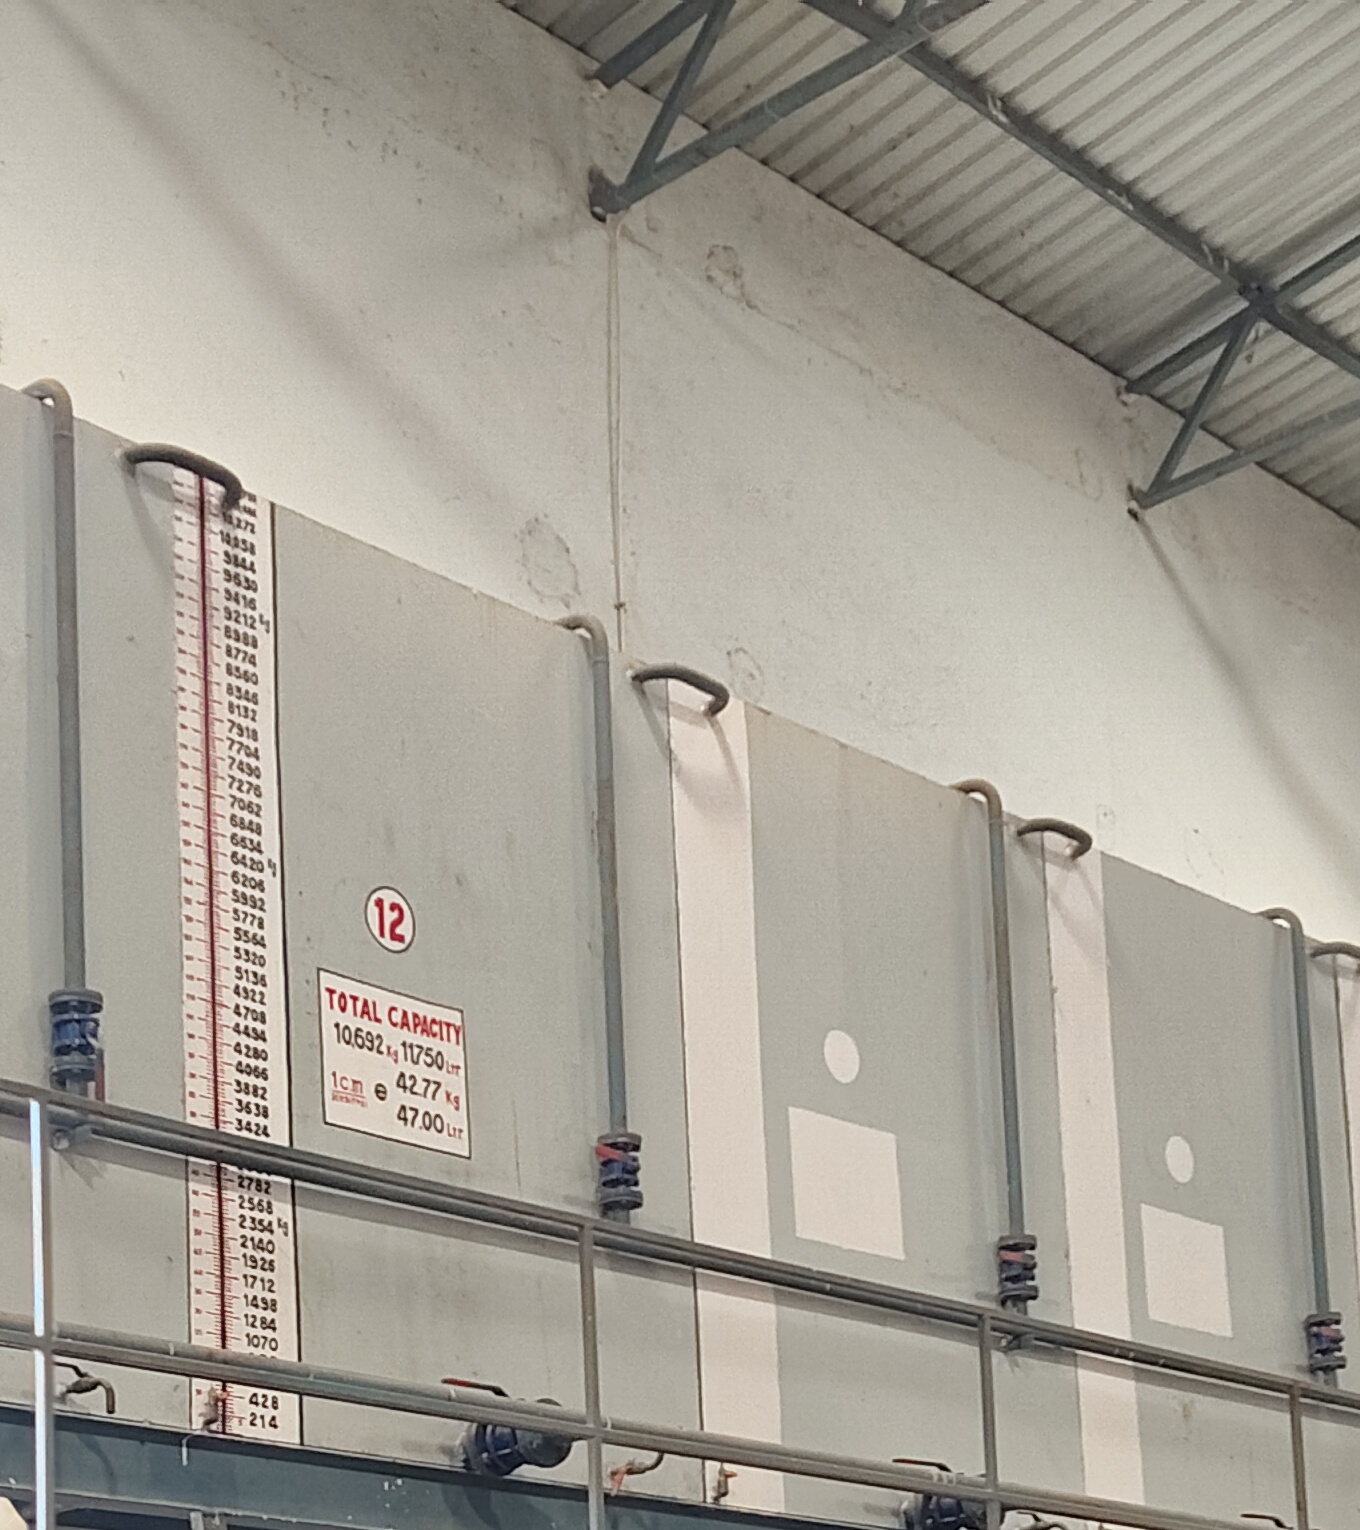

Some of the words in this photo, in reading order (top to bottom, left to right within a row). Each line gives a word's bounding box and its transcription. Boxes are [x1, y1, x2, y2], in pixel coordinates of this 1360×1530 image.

[223, 568, 258, 593] 9630
[223, 606, 257, 630] 9212
[225, 645, 257, 667] 8774
[227, 701, 257, 722] 8132
[226, 719, 258, 742] 7918
[228, 756, 261, 779] 7490
[227, 775, 262, 798] 7276
[229, 795, 262, 818] 7062
[229, 813, 262, 837] 6848
[229, 832, 263, 855] 6634
[230, 850, 265, 873] 6420
[231, 870, 265, 893] 6206
[231, 888, 266, 912] 5992
[232, 908, 265, 930] 5778
[374, 897, 405, 944] 12
[233, 927, 266, 949] 5564
[233, 946, 266, 968] 5320
[234, 966, 267, 988] 5136
[233, 984, 266, 1007] 4922
[232, 1004, 267, 1026] 4708
[325, 987, 382, 1024] TOTAL
[388, 1006, 461, 1046] CAPACITY
[232, 1021, 267, 1043] 4494
[334, 1021, 384, 1055] 10,692
[233, 1042, 268, 1062] 4280
[235, 1060, 269, 1082] 4066
[235, 1098, 269, 1120] 3638
[397, 1104, 445, 1134] 47.00
[235, 1118, 271, 1138] 3424
[237, 1174, 272, 1195] 2782
[238, 1195, 274, 1214] 2568
[238, 1215, 274, 1235] 2354
[277, 1216, 289, 1238] Kg
[240, 1234, 275, 1255] 2140
[241, 1253, 275, 1273] 1926
[242, 1273, 276, 1294] 1712
[243, 1294, 278, 1313] 1498
[243, 1313, 278, 1333] 1284
[245, 1332, 279, 1352] 1070
[248, 1392, 279, 1411] 428
[248, 1411, 279, 1430] 214
